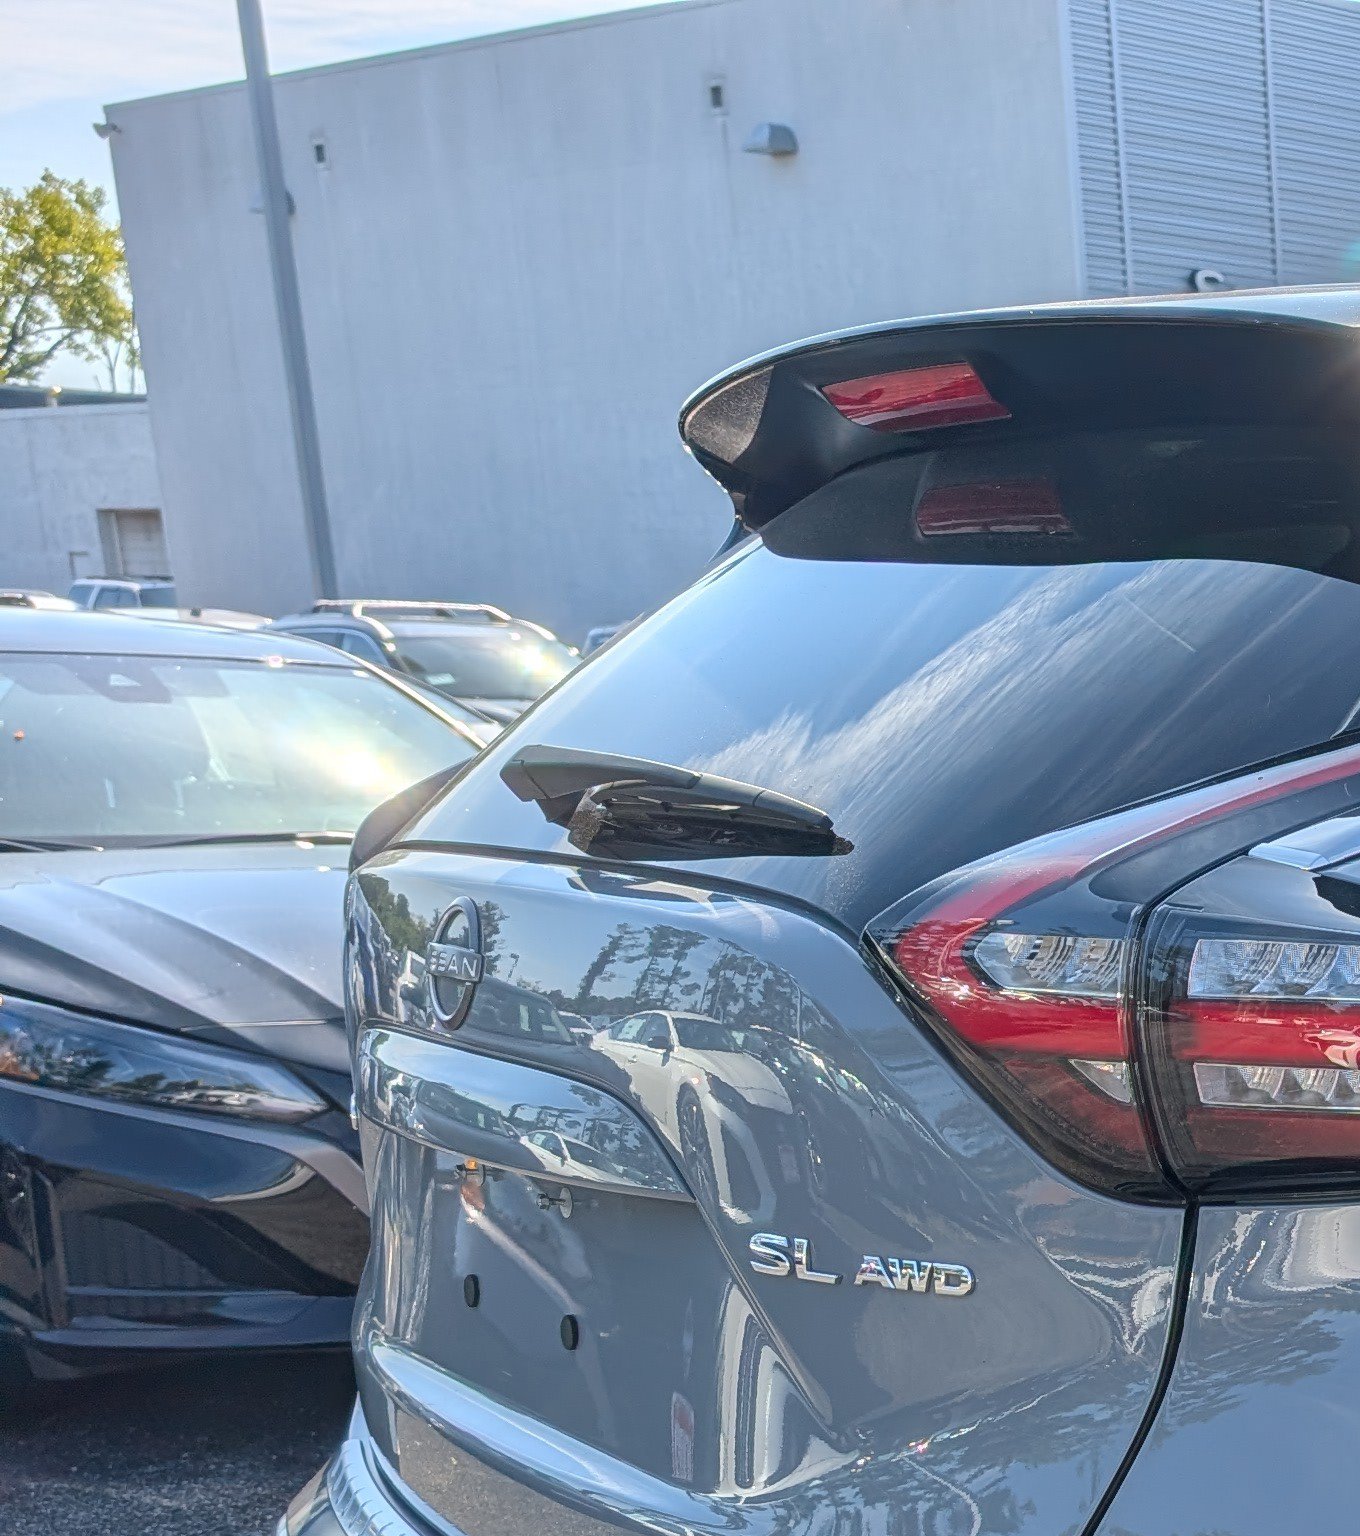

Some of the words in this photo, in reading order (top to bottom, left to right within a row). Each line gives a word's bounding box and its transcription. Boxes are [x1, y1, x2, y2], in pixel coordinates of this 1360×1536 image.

[429, 950, 479, 978] SSAN
[749, 1232, 843, 1285] SL
[854, 1254, 976, 1297] AWD
